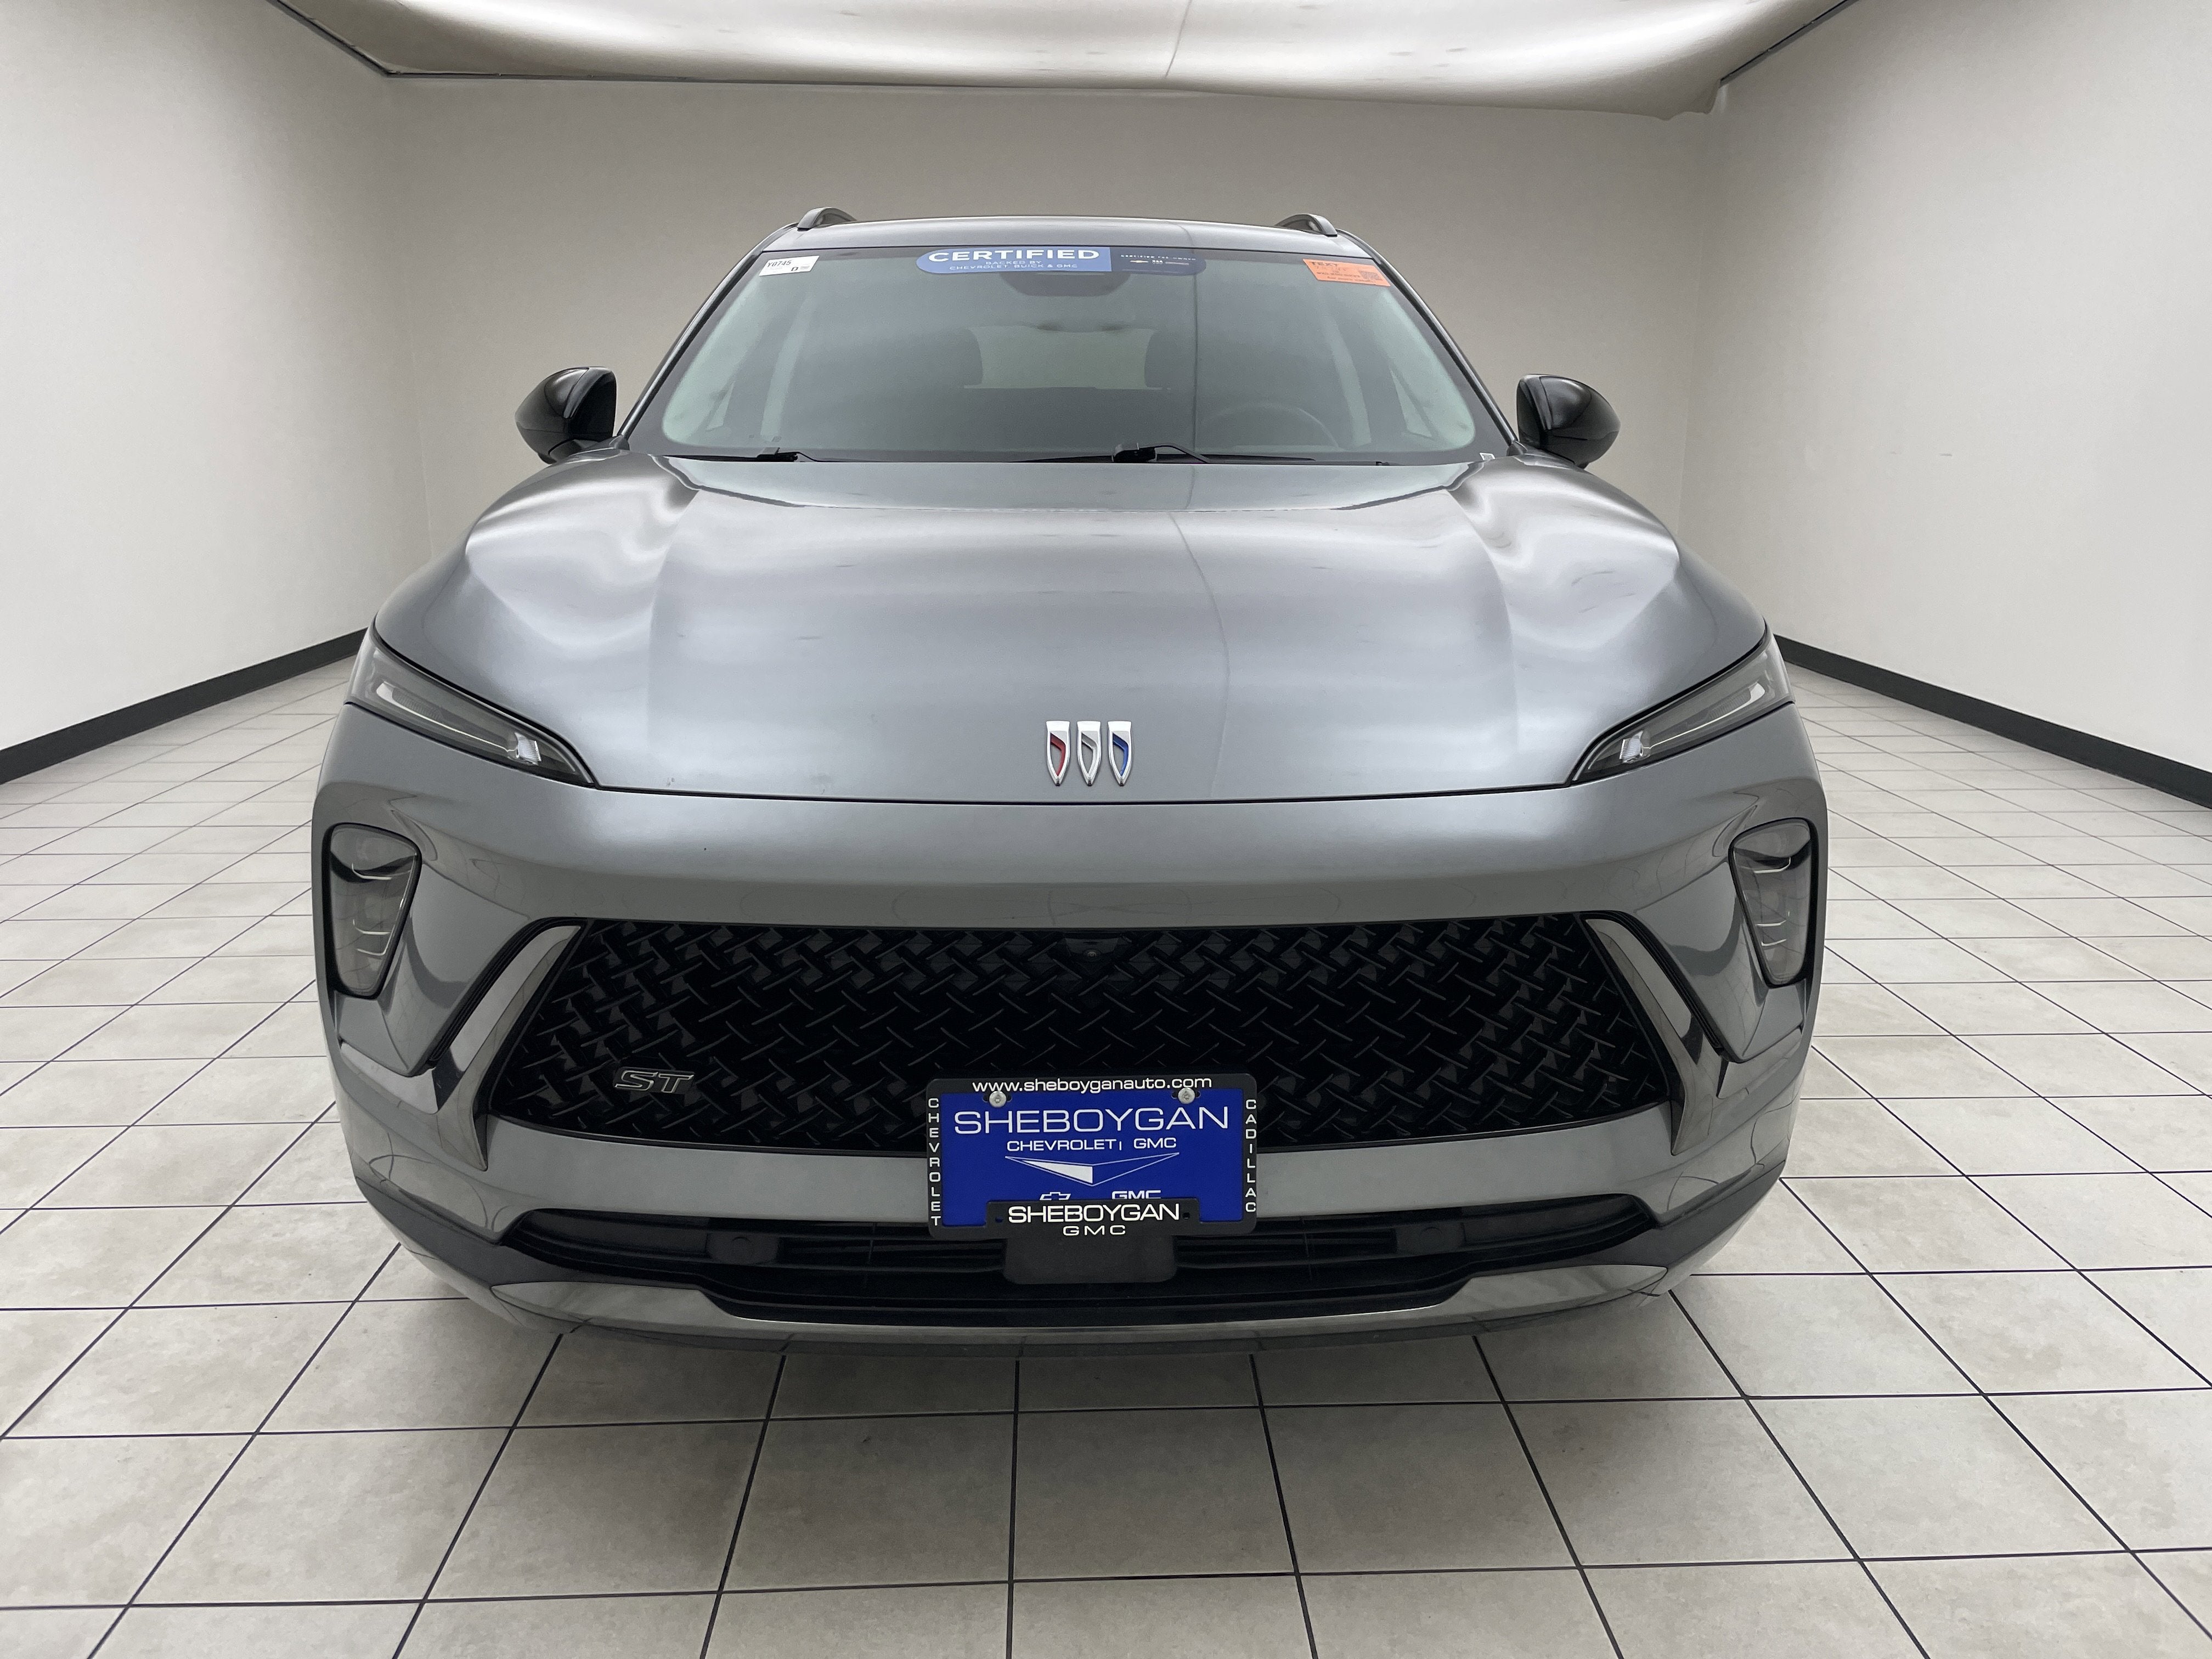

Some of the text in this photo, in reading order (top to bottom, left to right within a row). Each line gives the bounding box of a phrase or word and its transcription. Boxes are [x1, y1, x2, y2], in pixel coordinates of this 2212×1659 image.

[928, 250, 1099, 262] CERTIFIED
[614, 1070, 695, 1093] ST
[972, 1077, 1212, 1094] www.sheboyganauto.com
[954, 1106, 1228, 1135] SHEBOYGAN
[1007, 1137, 1177, 1152] CHEVROLET GMC
[928, 1098, 941, 1226] CHEVROLET
[1245, 1099, 1257, 1213] CADILLAC
[1111, 1189, 1161, 1199] GMC
[1008, 1203, 1180, 1223] SHEBOYGAN
[1063, 1225, 1126, 1236] GMC
